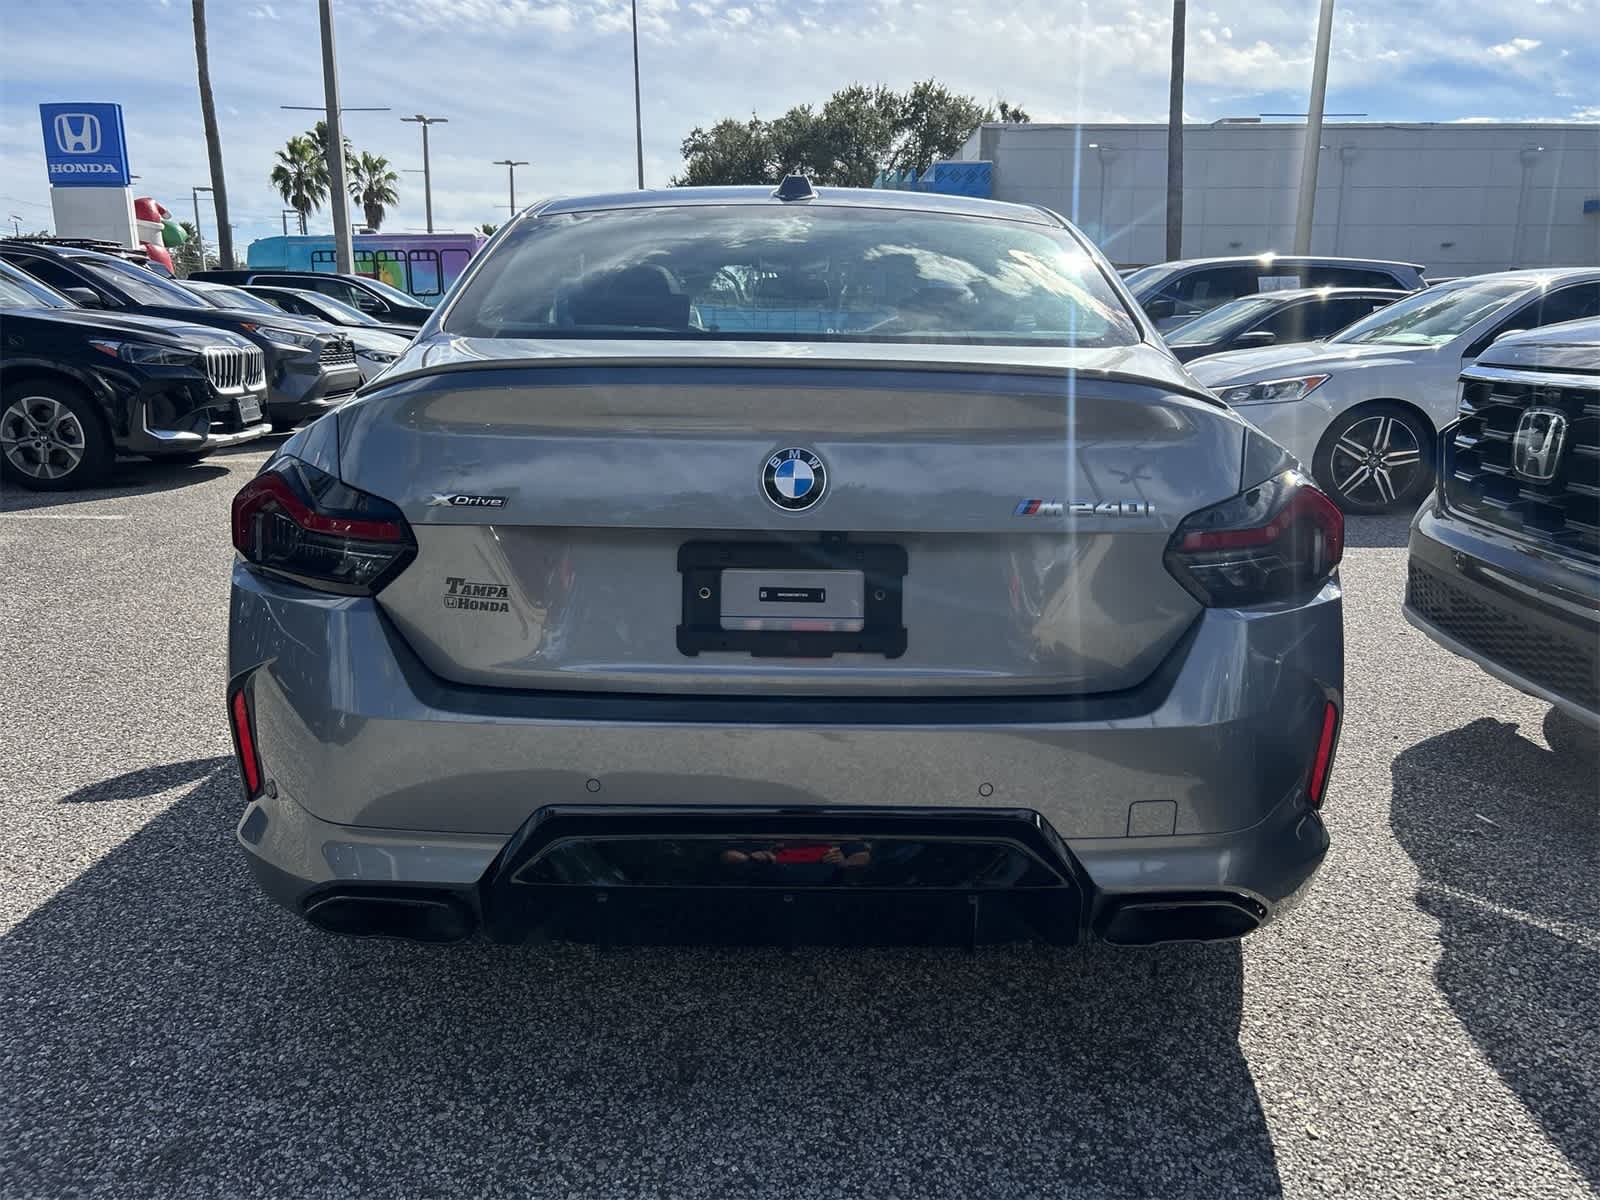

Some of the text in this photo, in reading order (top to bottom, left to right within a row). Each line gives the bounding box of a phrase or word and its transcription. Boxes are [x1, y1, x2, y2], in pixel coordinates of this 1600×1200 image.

[49, 163, 119, 174] HONDA
[769, 449, 821, 469] BMW
[446, 576, 508, 598] TAMPA
[457, 598, 509, 613] HONDA
